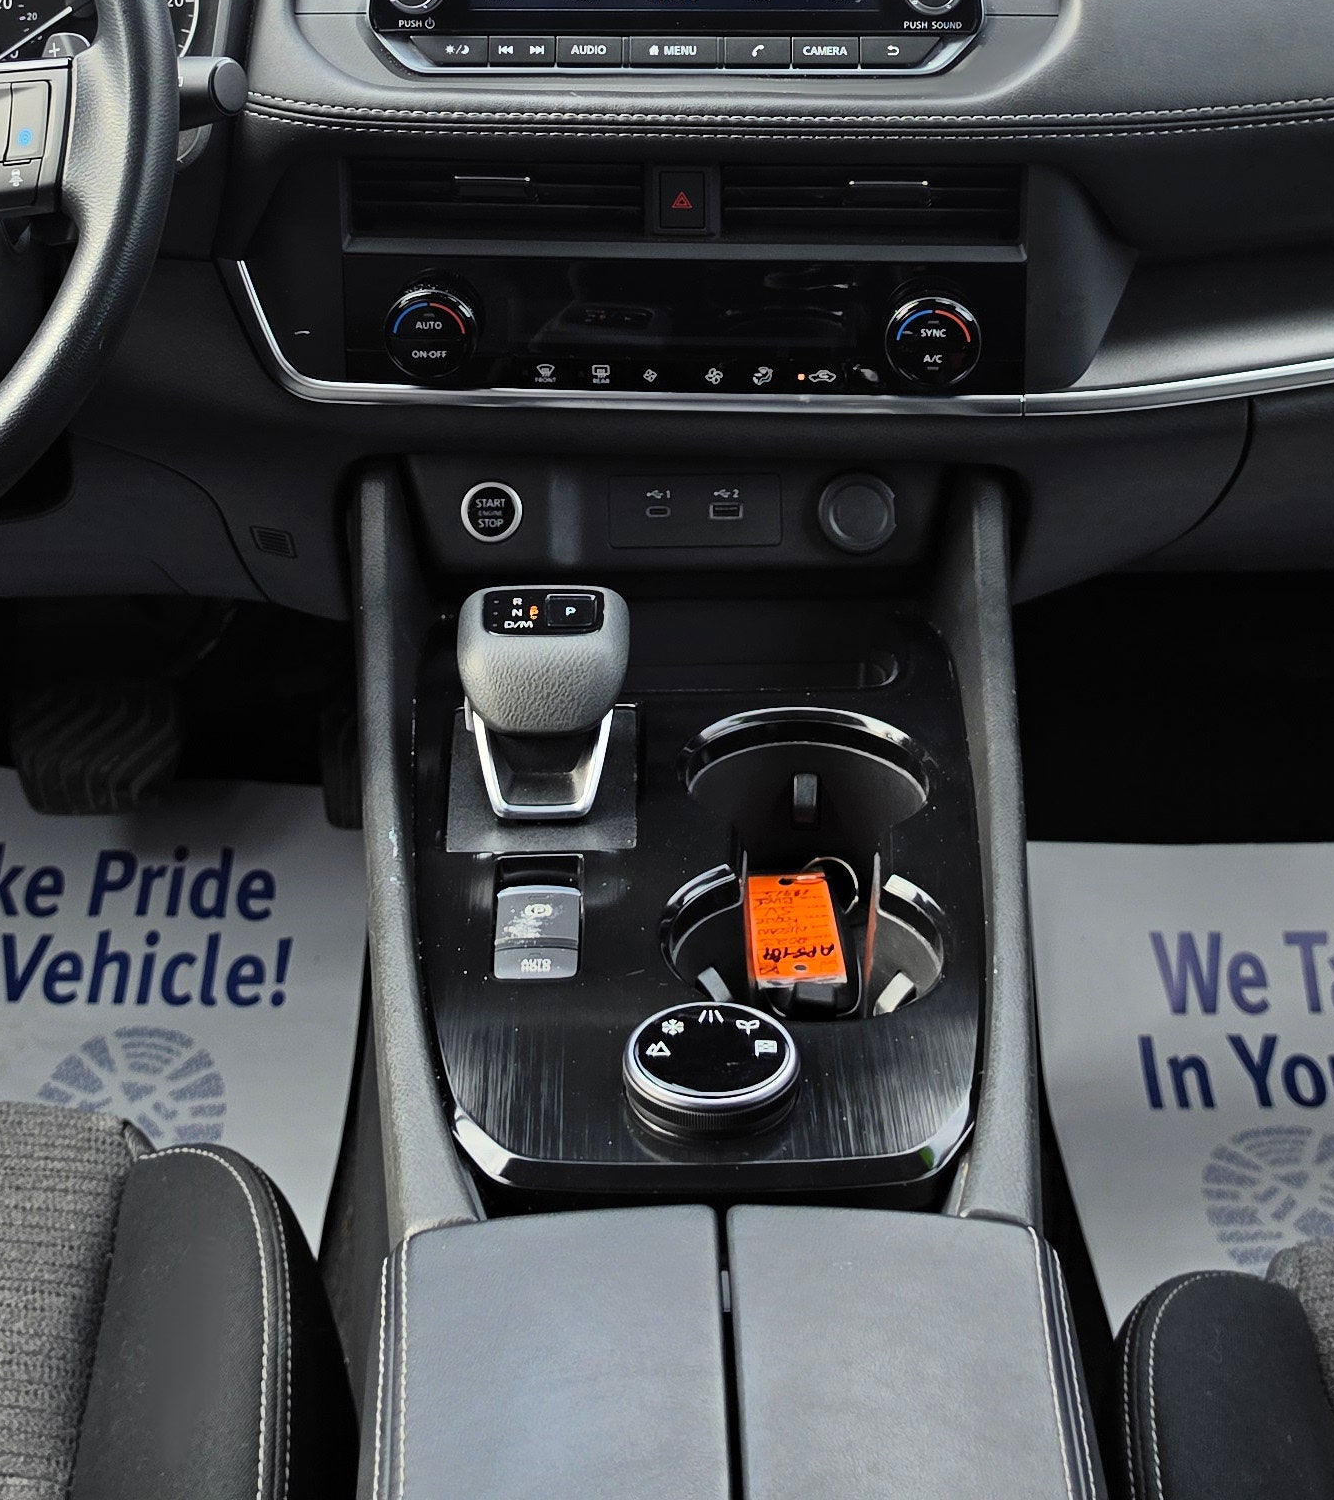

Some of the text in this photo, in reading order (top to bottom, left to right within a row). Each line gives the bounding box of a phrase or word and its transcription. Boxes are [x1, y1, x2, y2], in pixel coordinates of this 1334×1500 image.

[26, 12, 38, 21] 20
[398, 19, 422, 28] PUSH
[903, 20, 962, 30] PUSH SOUND
[570, 45, 607, 55] AUDIO
[663, 45, 697, 55] MENU
[802, 46, 848, 56] CAMERA
[415, 321, 443, 330] AUTO
[920, 328, 947, 338] SYNC
[923, 354, 943, 364] A/C
[665, 489, 672, 499] 1
[732, 489, 740, 498] 2
[475, 499, 506, 508] START
[478, 519, 505, 528] STOP
[512, 597, 523, 606] R
[511, 608, 523, 617] N
[565, 606, 577, 616] P
[504, 620, 534, 629] D/M
[86, 846, 277, 923] Pride
[0, 930, 295, 1009] Vehicle!
[1149, 929, 1269, 1017] We
[1138, 1035, 1215, 1112] In
